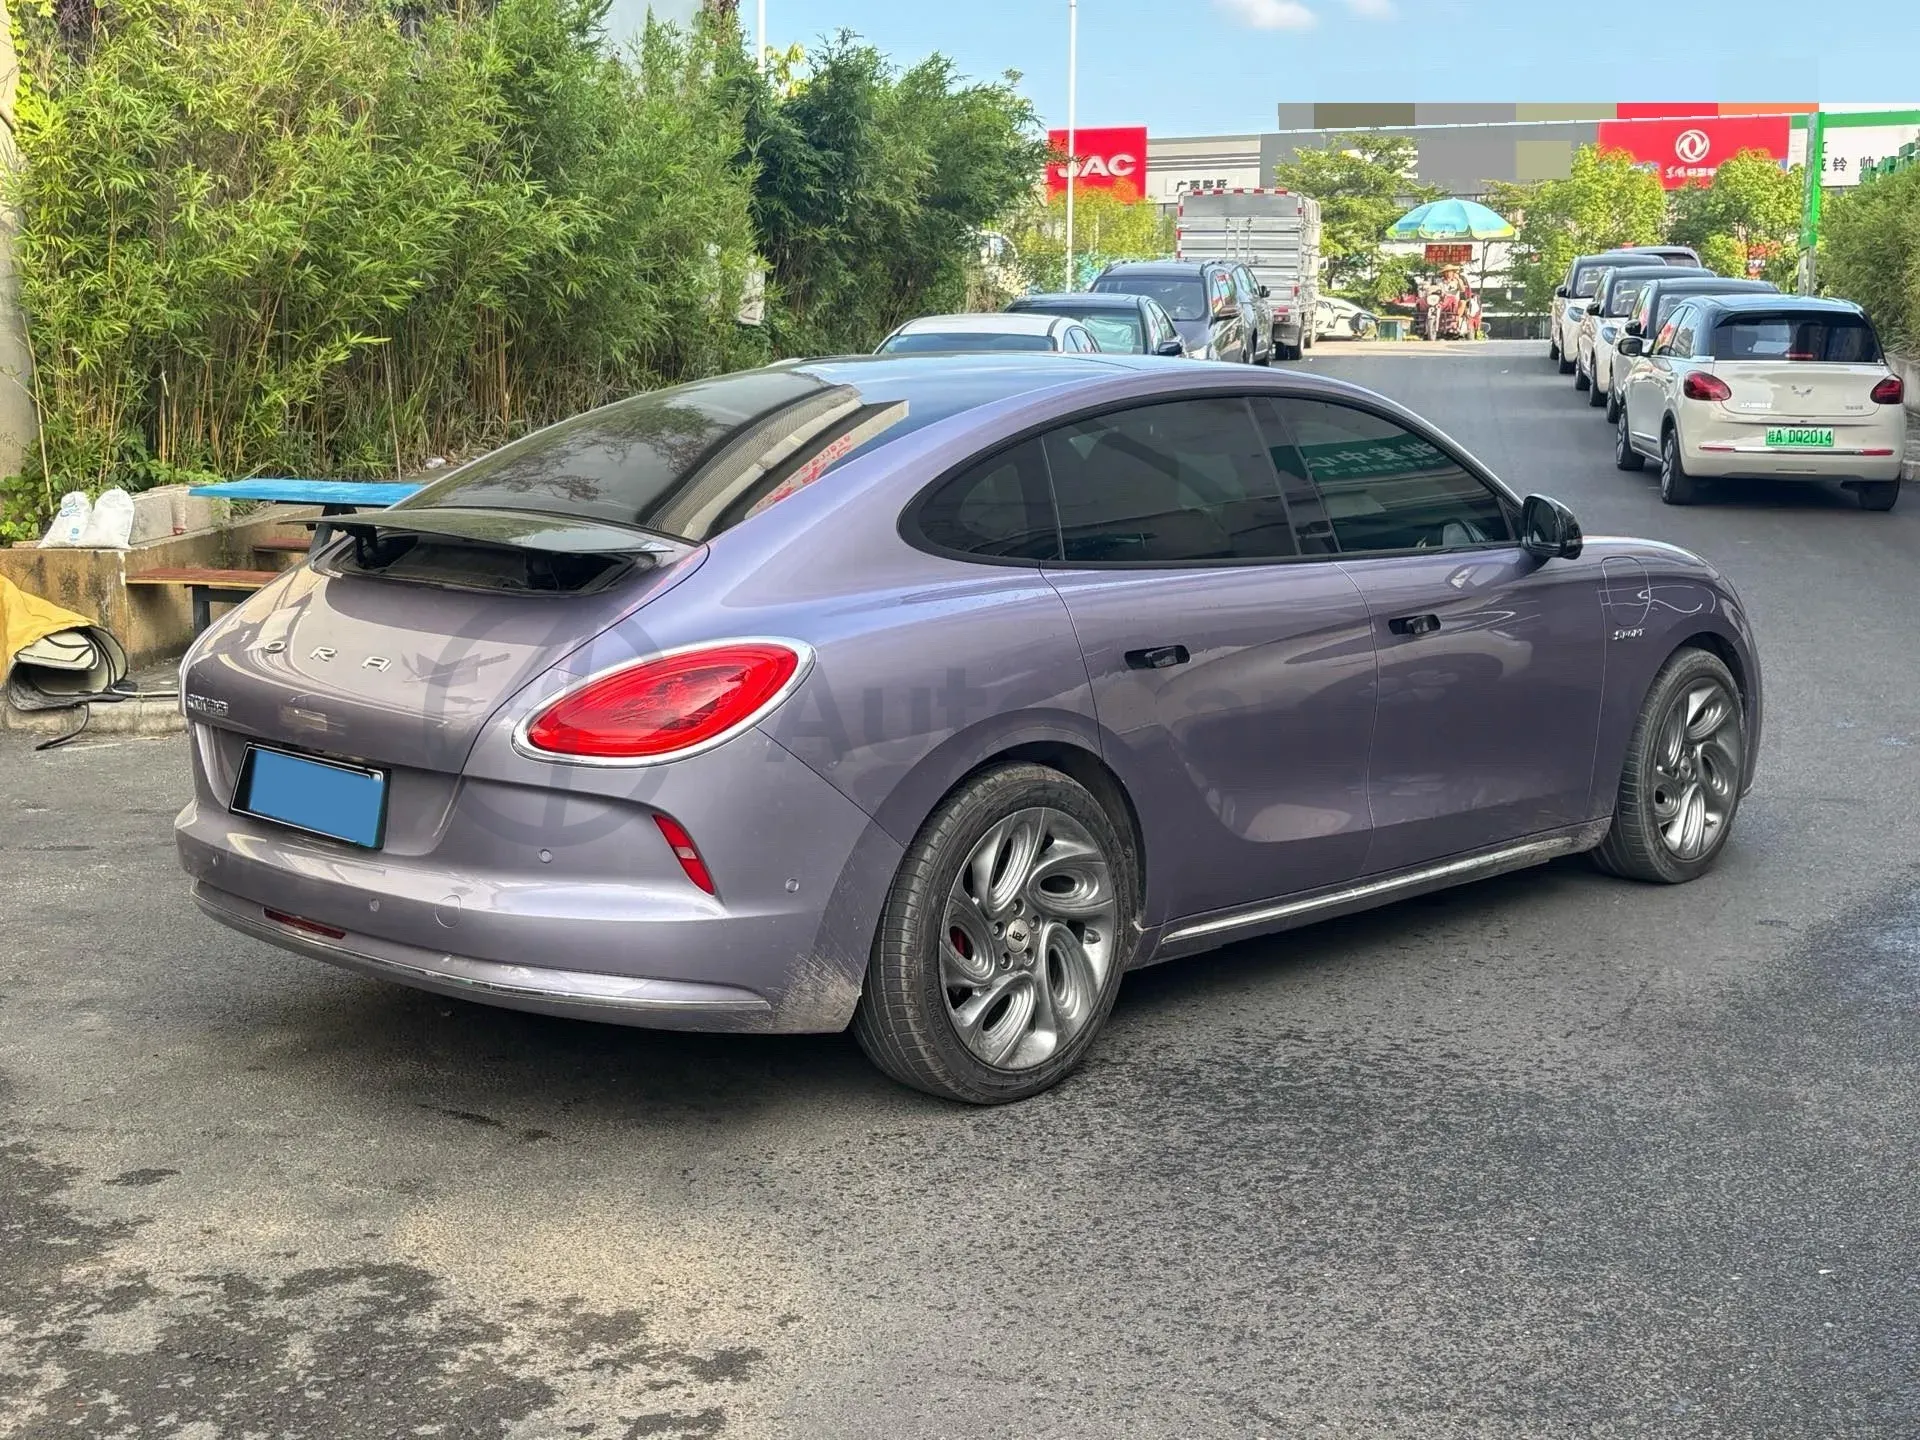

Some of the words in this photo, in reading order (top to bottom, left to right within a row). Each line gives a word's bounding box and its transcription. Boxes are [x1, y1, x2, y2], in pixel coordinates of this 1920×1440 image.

[1057, 153, 1136, 177] JAC
[1788, 429, 1832, 444] DQ2014
[265, 640, 393, 673] ORA
